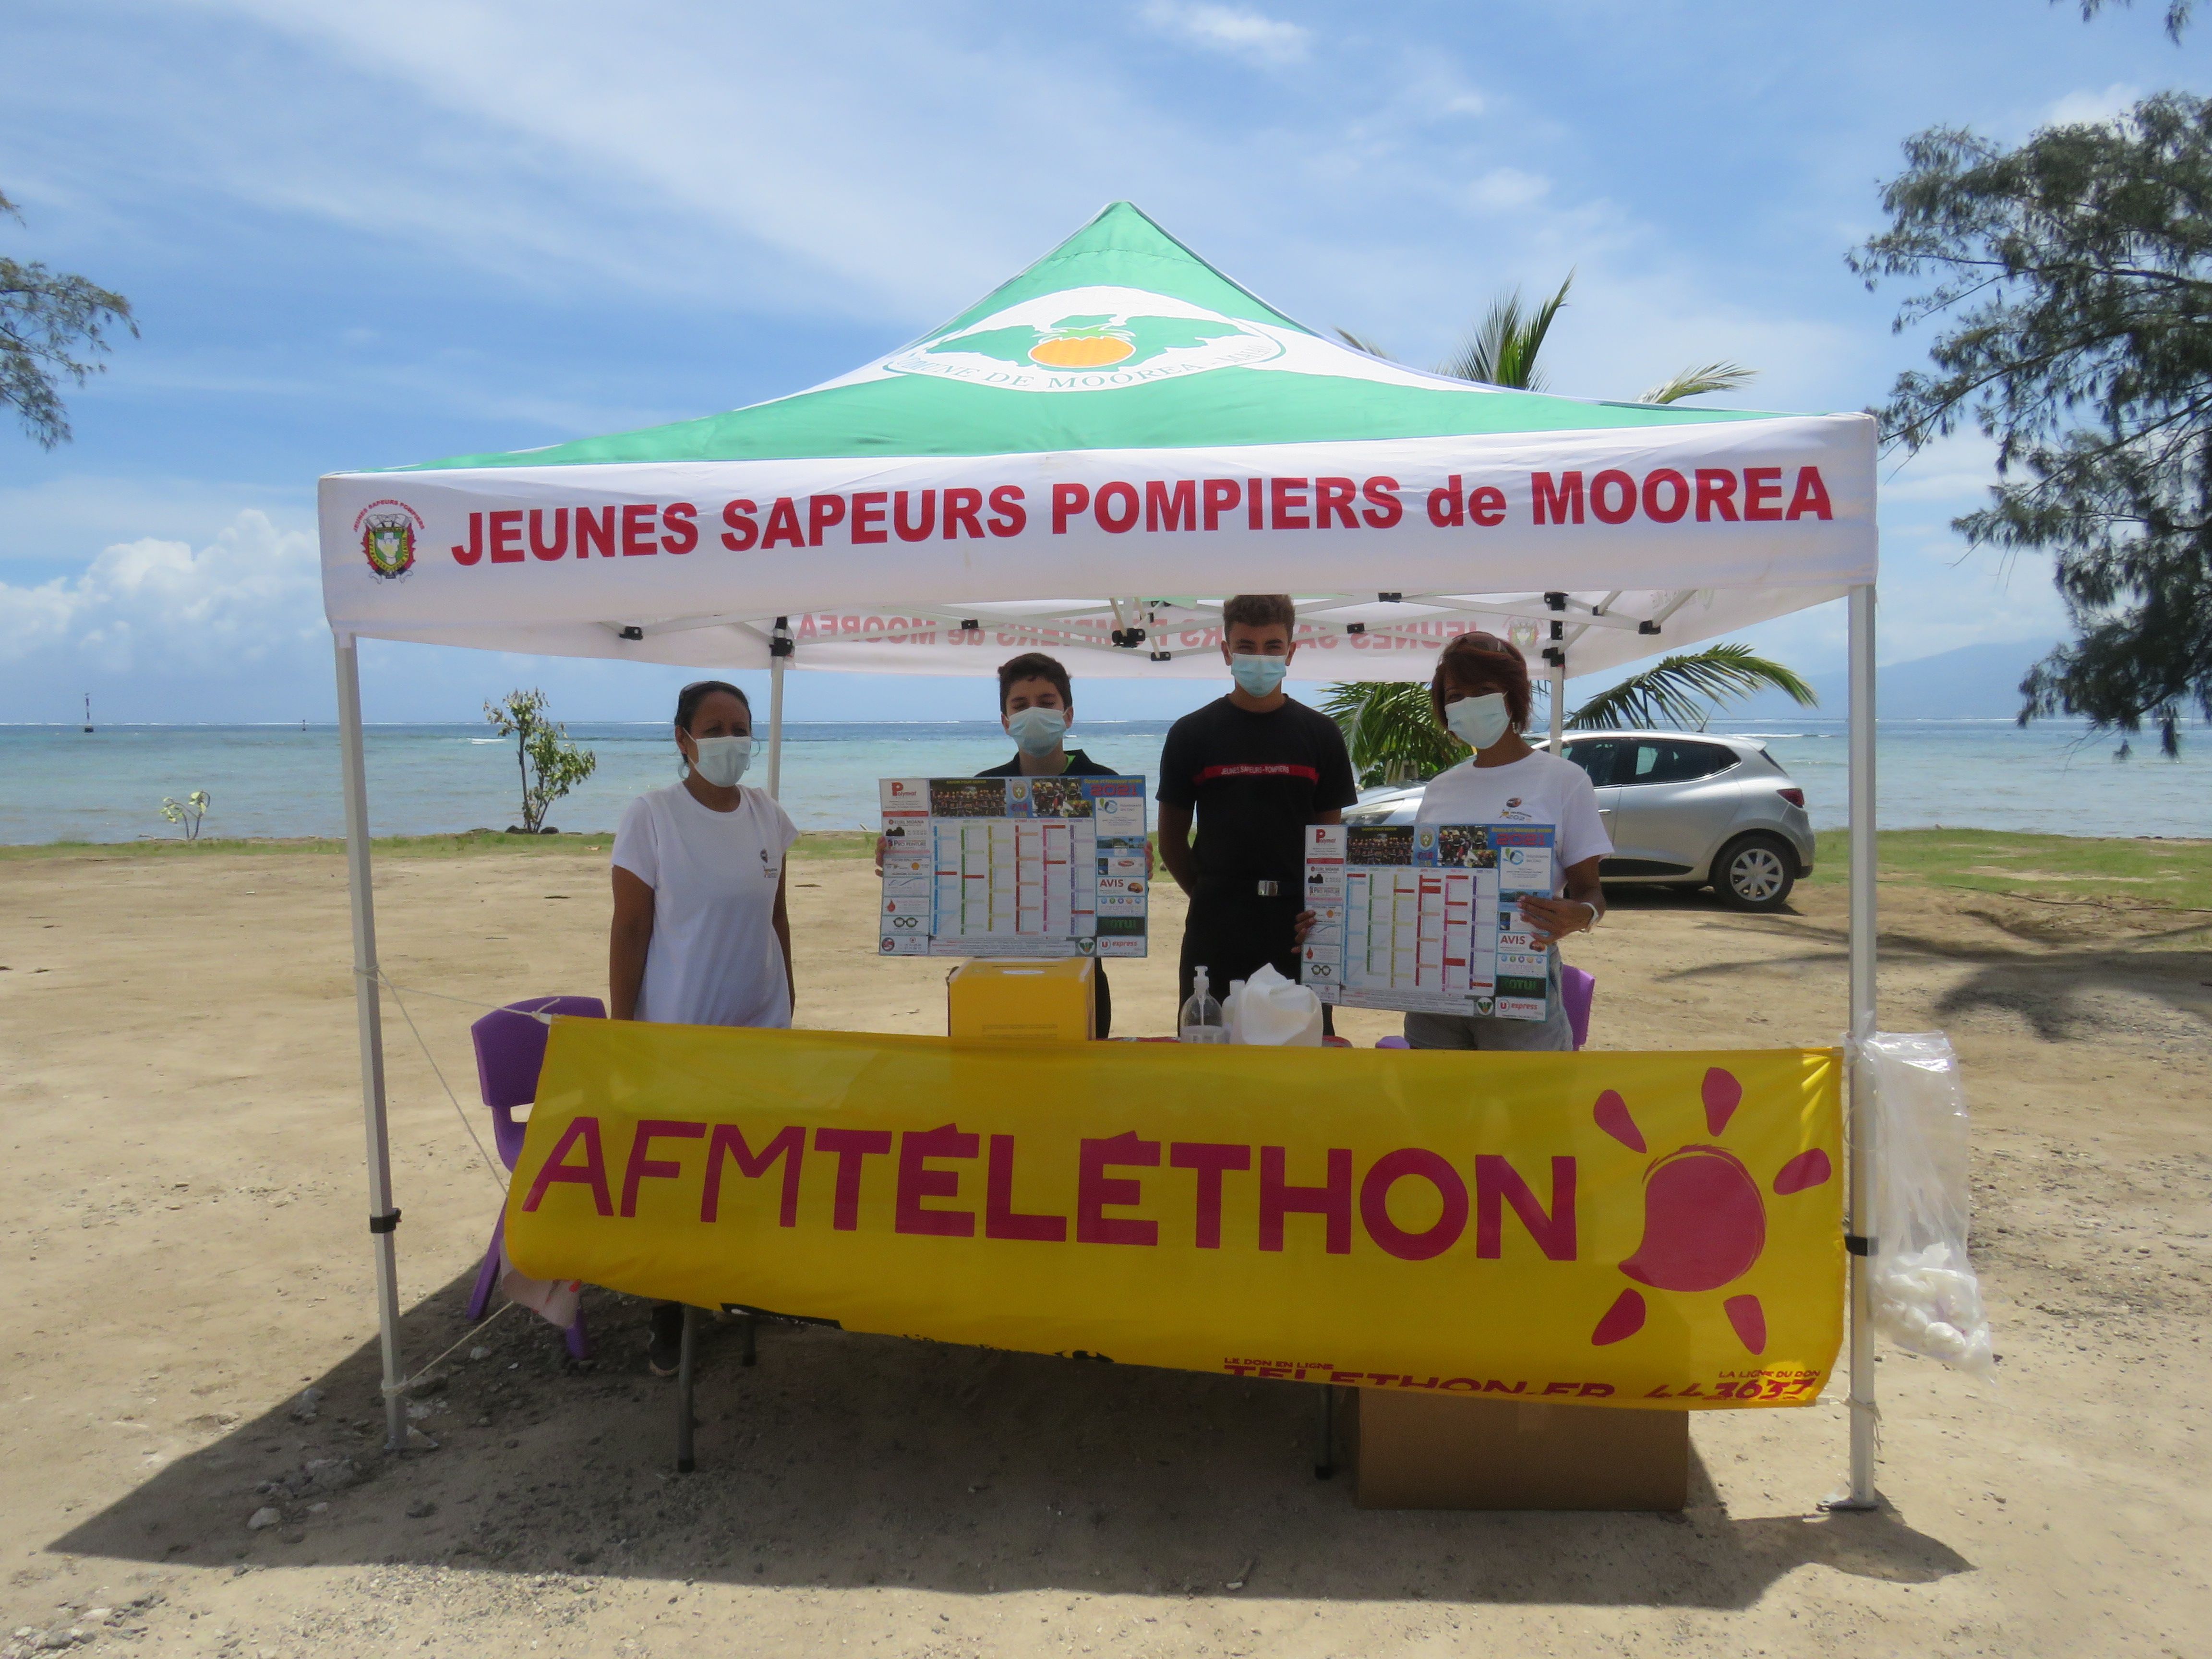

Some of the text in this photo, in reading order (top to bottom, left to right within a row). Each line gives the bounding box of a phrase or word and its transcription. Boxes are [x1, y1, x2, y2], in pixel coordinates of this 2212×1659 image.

[984, 372, 1034, 387] DE
[1047, 362, 1205, 388] MOOREA
[452, 503, 698, 565] JEUNES
[721, 485, 1026, 551] SAPEURS
[1053, 476, 1403, 534] POMPIERS
[1427, 475, 1506, 527] de
[1531, 467, 1832, 525] MOOREA
[1090, 784, 1137, 796] 2021
[1496, 833, 1545, 845] 2021
[1100, 879, 1124, 888] AVIS
[1501, 935, 1526, 945] AVIS
[1244, 1358, 1272, 1366] DON
[1297, 1362, 1334, 1370] LIGNE
[1794, 1370, 1820, 1378] DON
